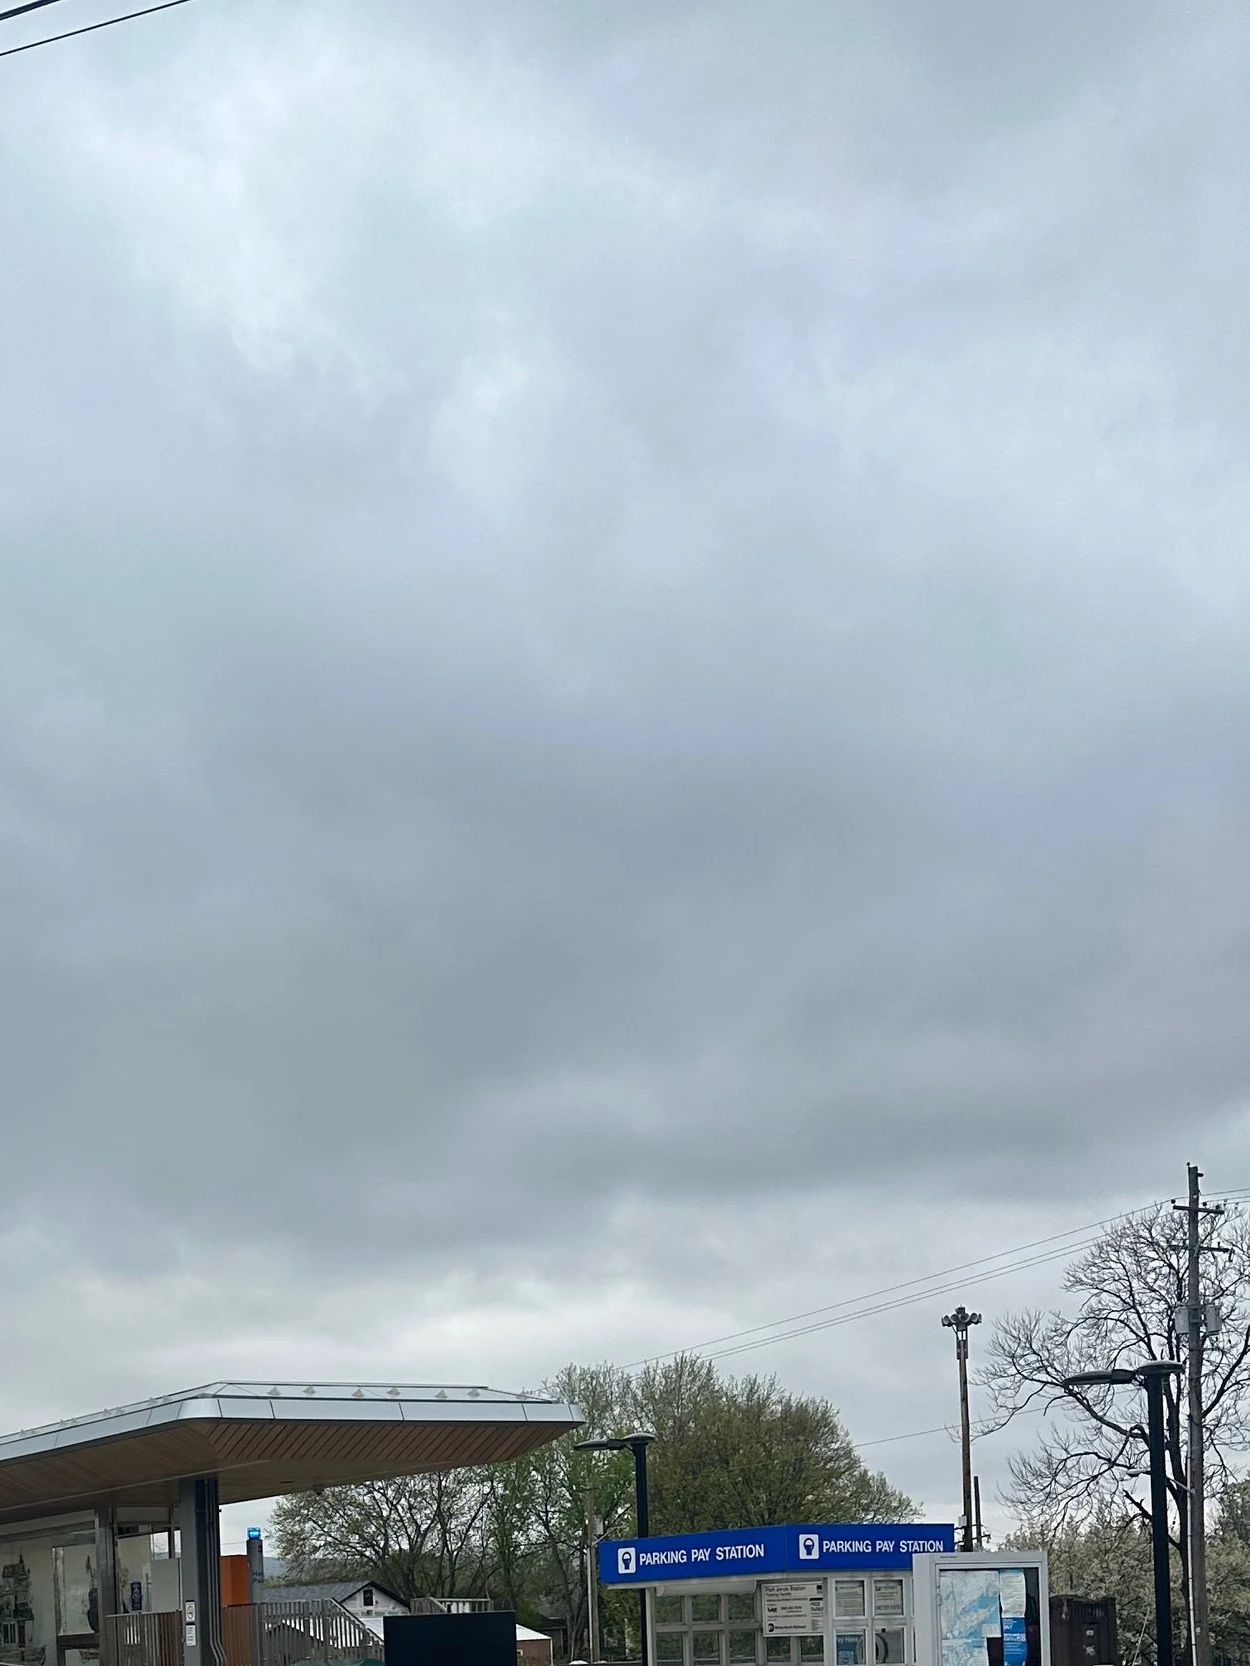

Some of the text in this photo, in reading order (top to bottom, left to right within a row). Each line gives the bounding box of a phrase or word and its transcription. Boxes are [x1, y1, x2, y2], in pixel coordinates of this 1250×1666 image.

[639, 1543, 764, 1566] PARKING PAY STATION
[823, 1540, 943, 1553] PARKING PAY STATION
